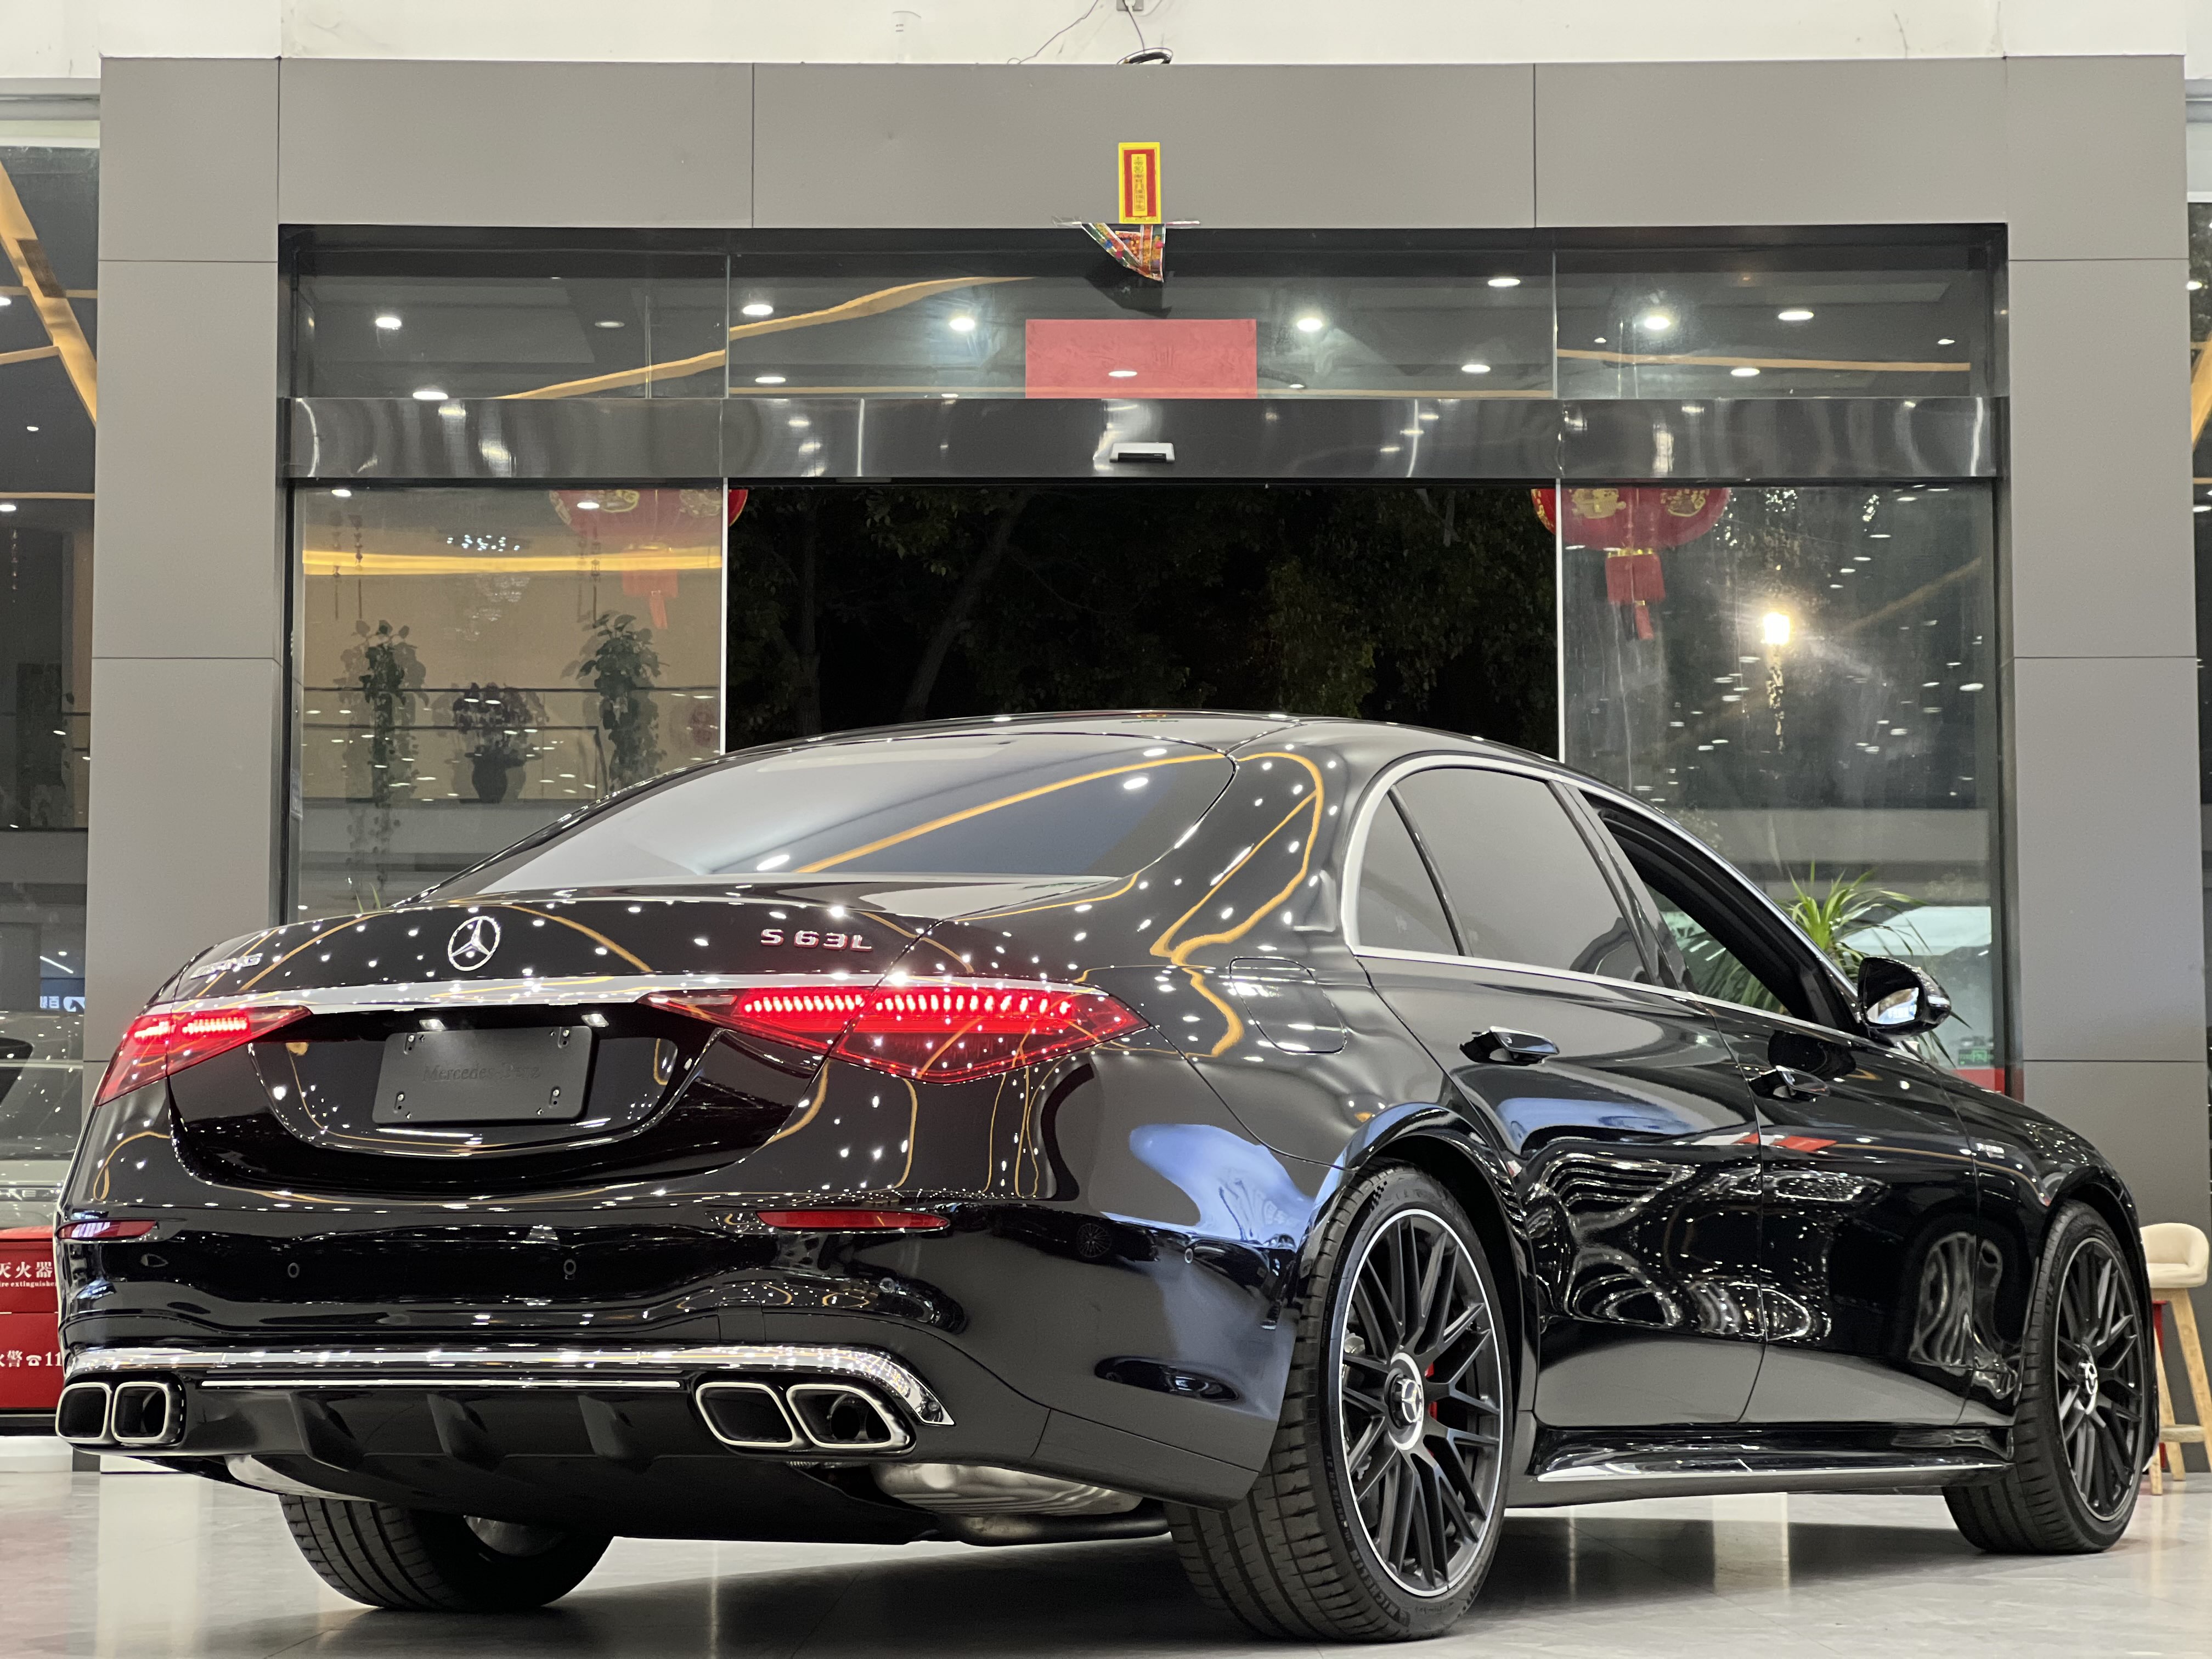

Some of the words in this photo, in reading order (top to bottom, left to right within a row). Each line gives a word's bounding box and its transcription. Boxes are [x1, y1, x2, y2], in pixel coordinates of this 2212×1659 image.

[761, 929, 784, 946] S
[794, 930, 873, 952] 63L
[1350, 1549, 1400, 1616] MICHELIN
